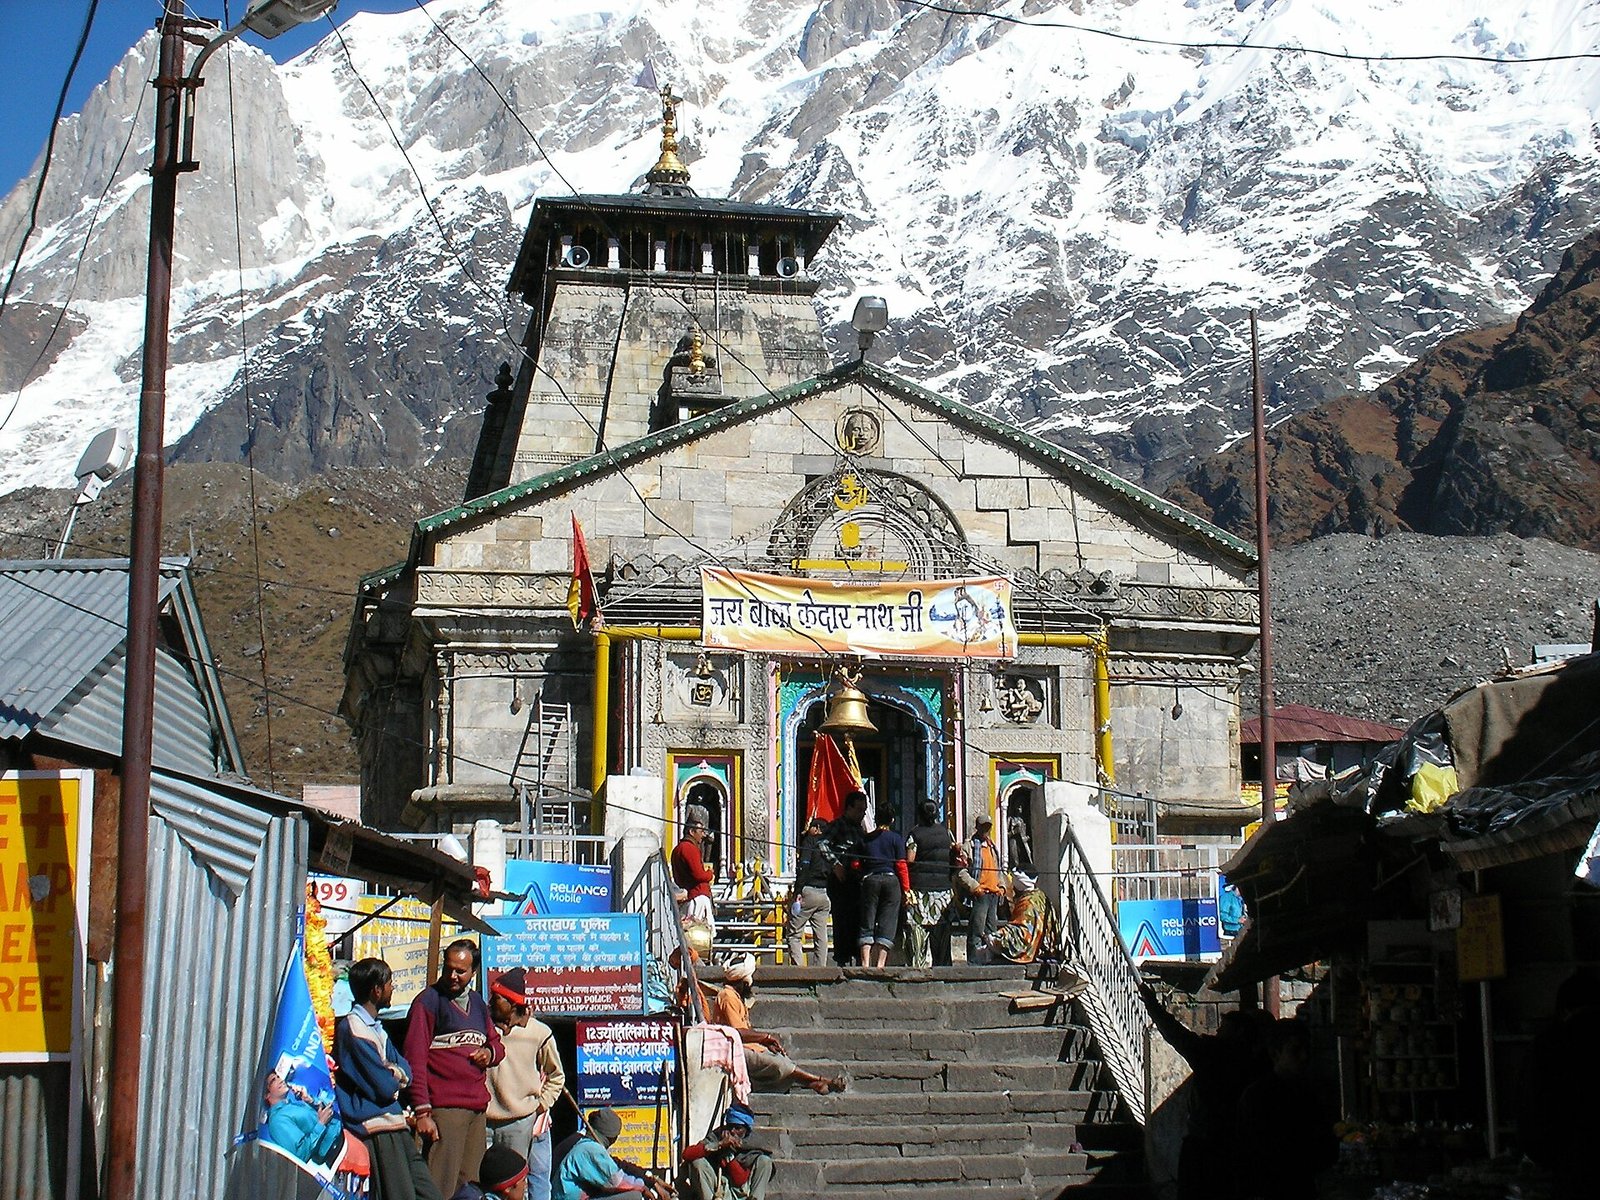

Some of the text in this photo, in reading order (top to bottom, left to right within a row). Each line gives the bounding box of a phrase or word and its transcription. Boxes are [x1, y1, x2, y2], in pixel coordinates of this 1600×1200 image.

[709, 590, 923, 633] जय बाबा केदार नाथ जी
[314, 882, 347, 901] 99
[550, 892, 582, 903] Mobile
[580, 917, 611, 934] पुलिस
[584, 994, 612, 1004] POLICE
[661, 1022, 674, 1040] से
[641, 1039, 671, 1056] आपके
[583, 1058, 608, 1075] जीवन
